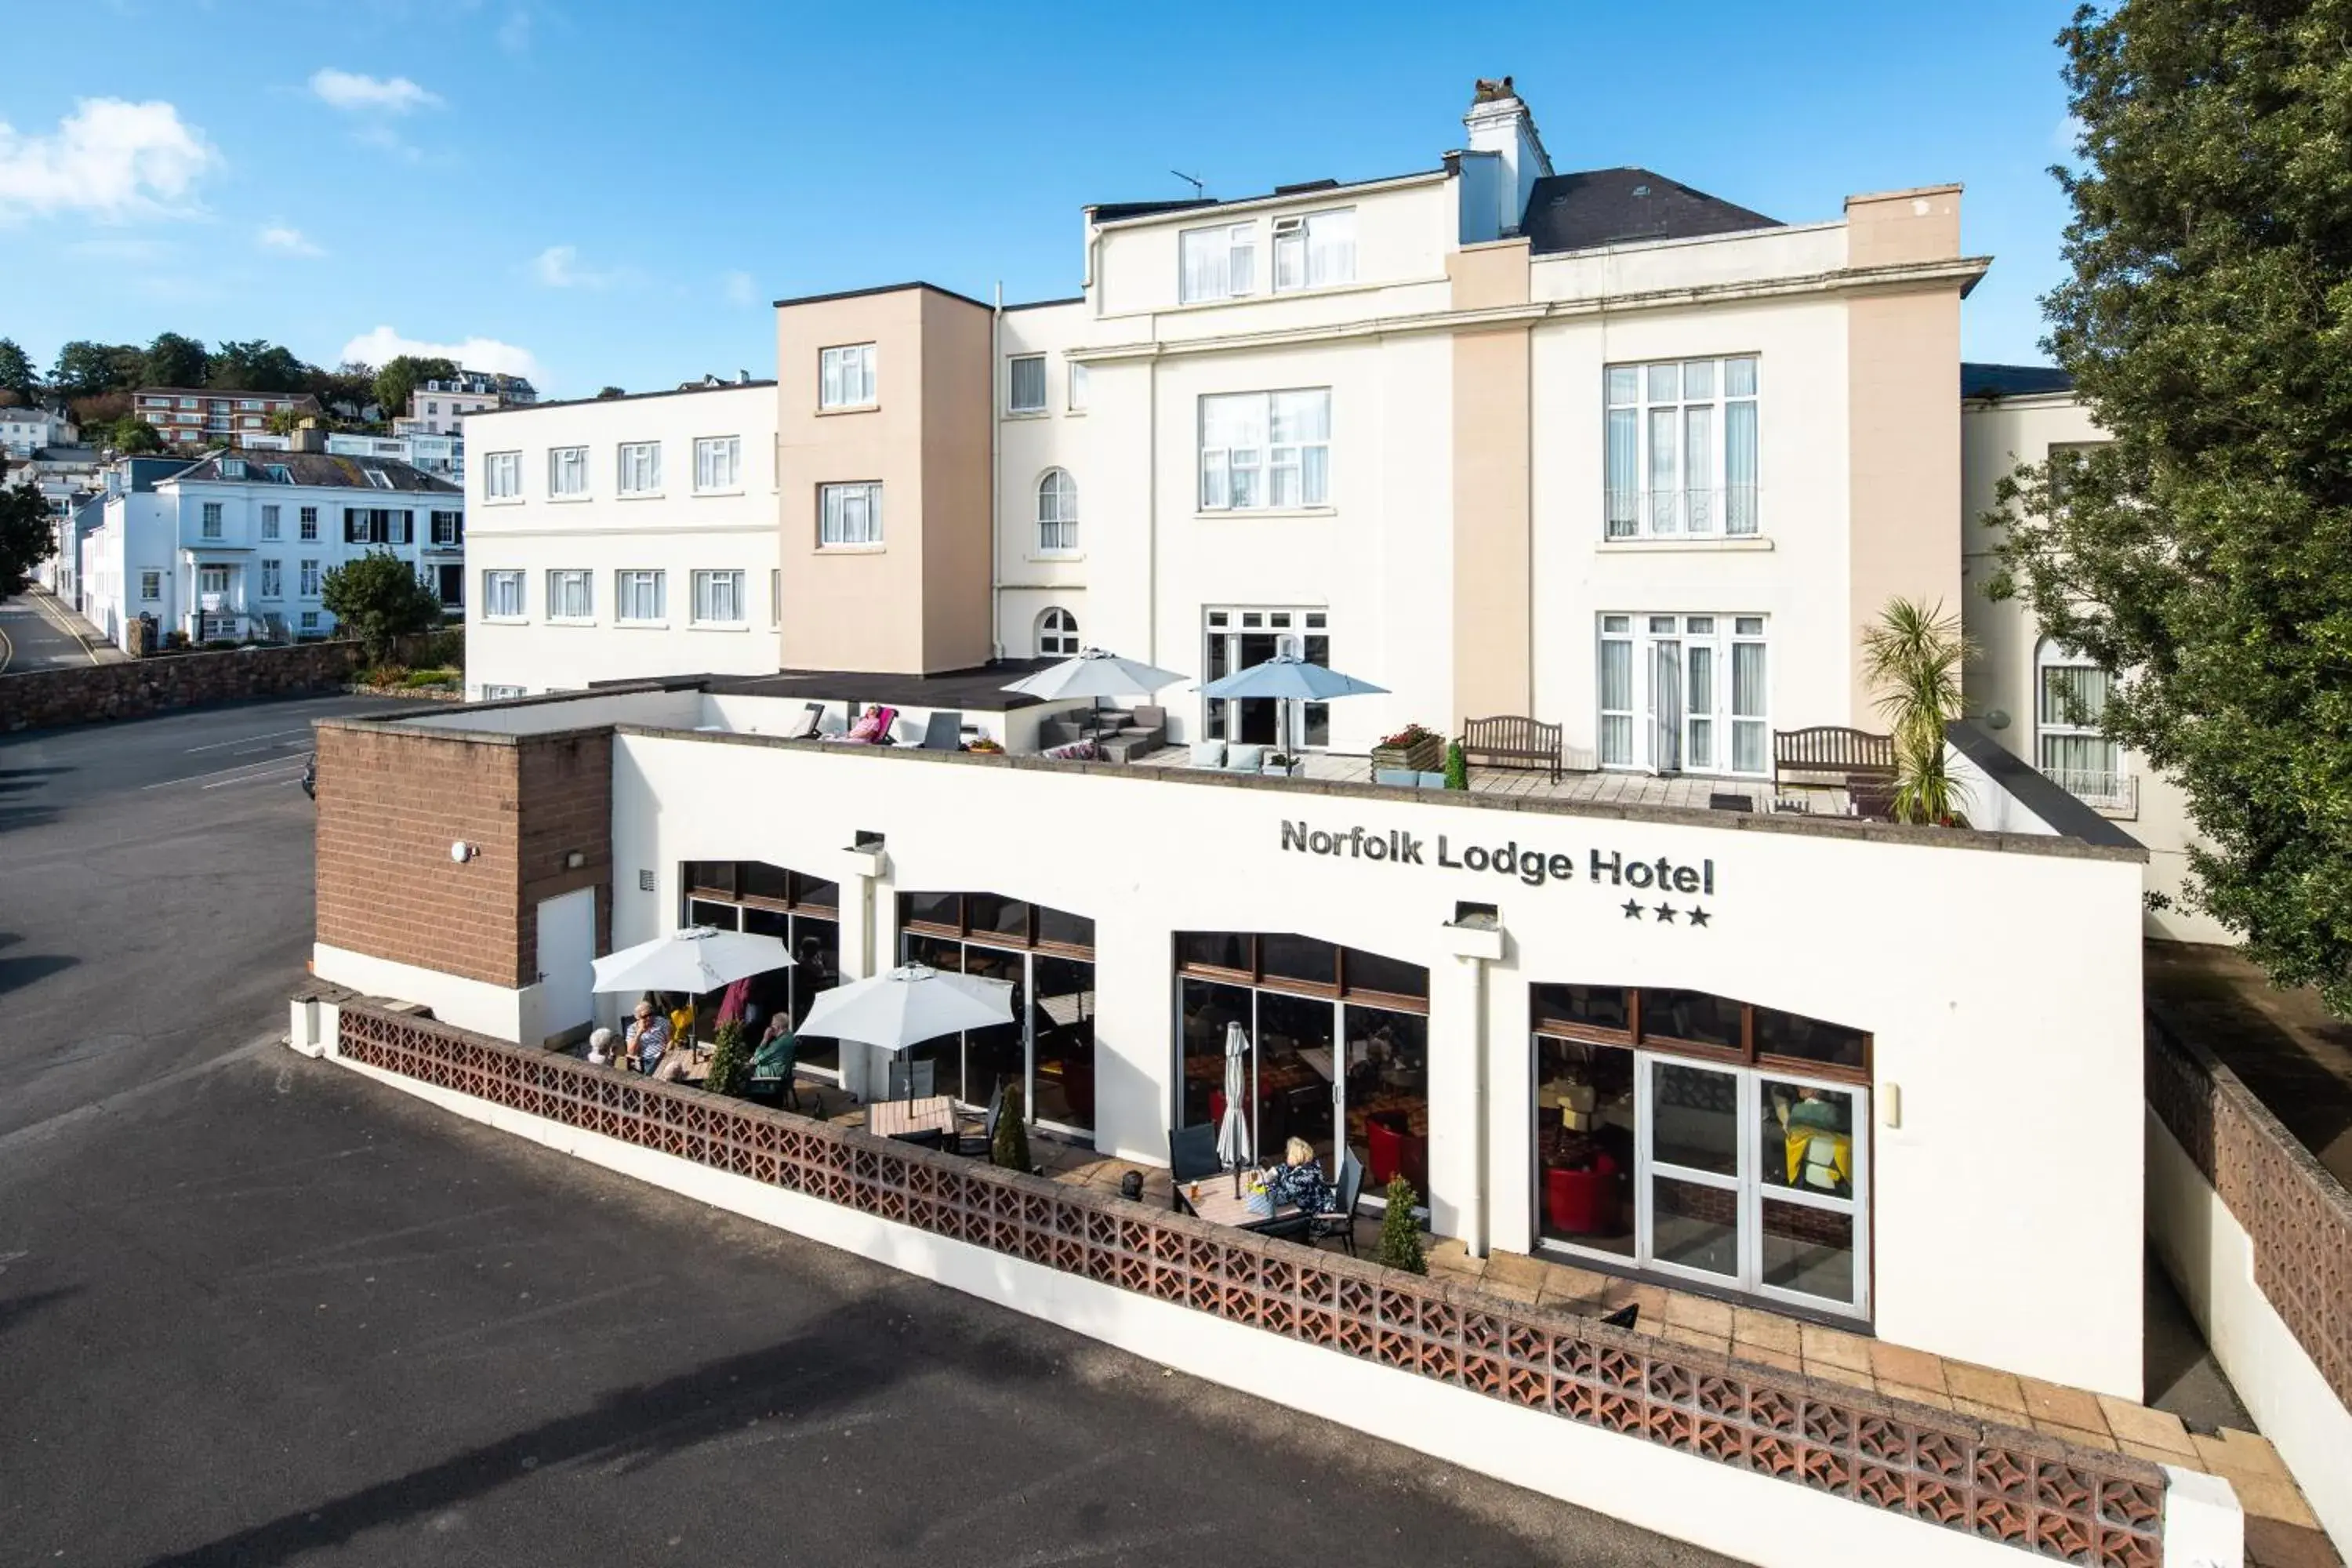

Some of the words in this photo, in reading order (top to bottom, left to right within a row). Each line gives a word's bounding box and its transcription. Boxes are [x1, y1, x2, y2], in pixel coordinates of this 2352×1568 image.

[1281, 819, 1424, 865] Norfolk
[1438, 835, 1574, 887] Lodge
[1590, 848, 1715, 895] Hotel
